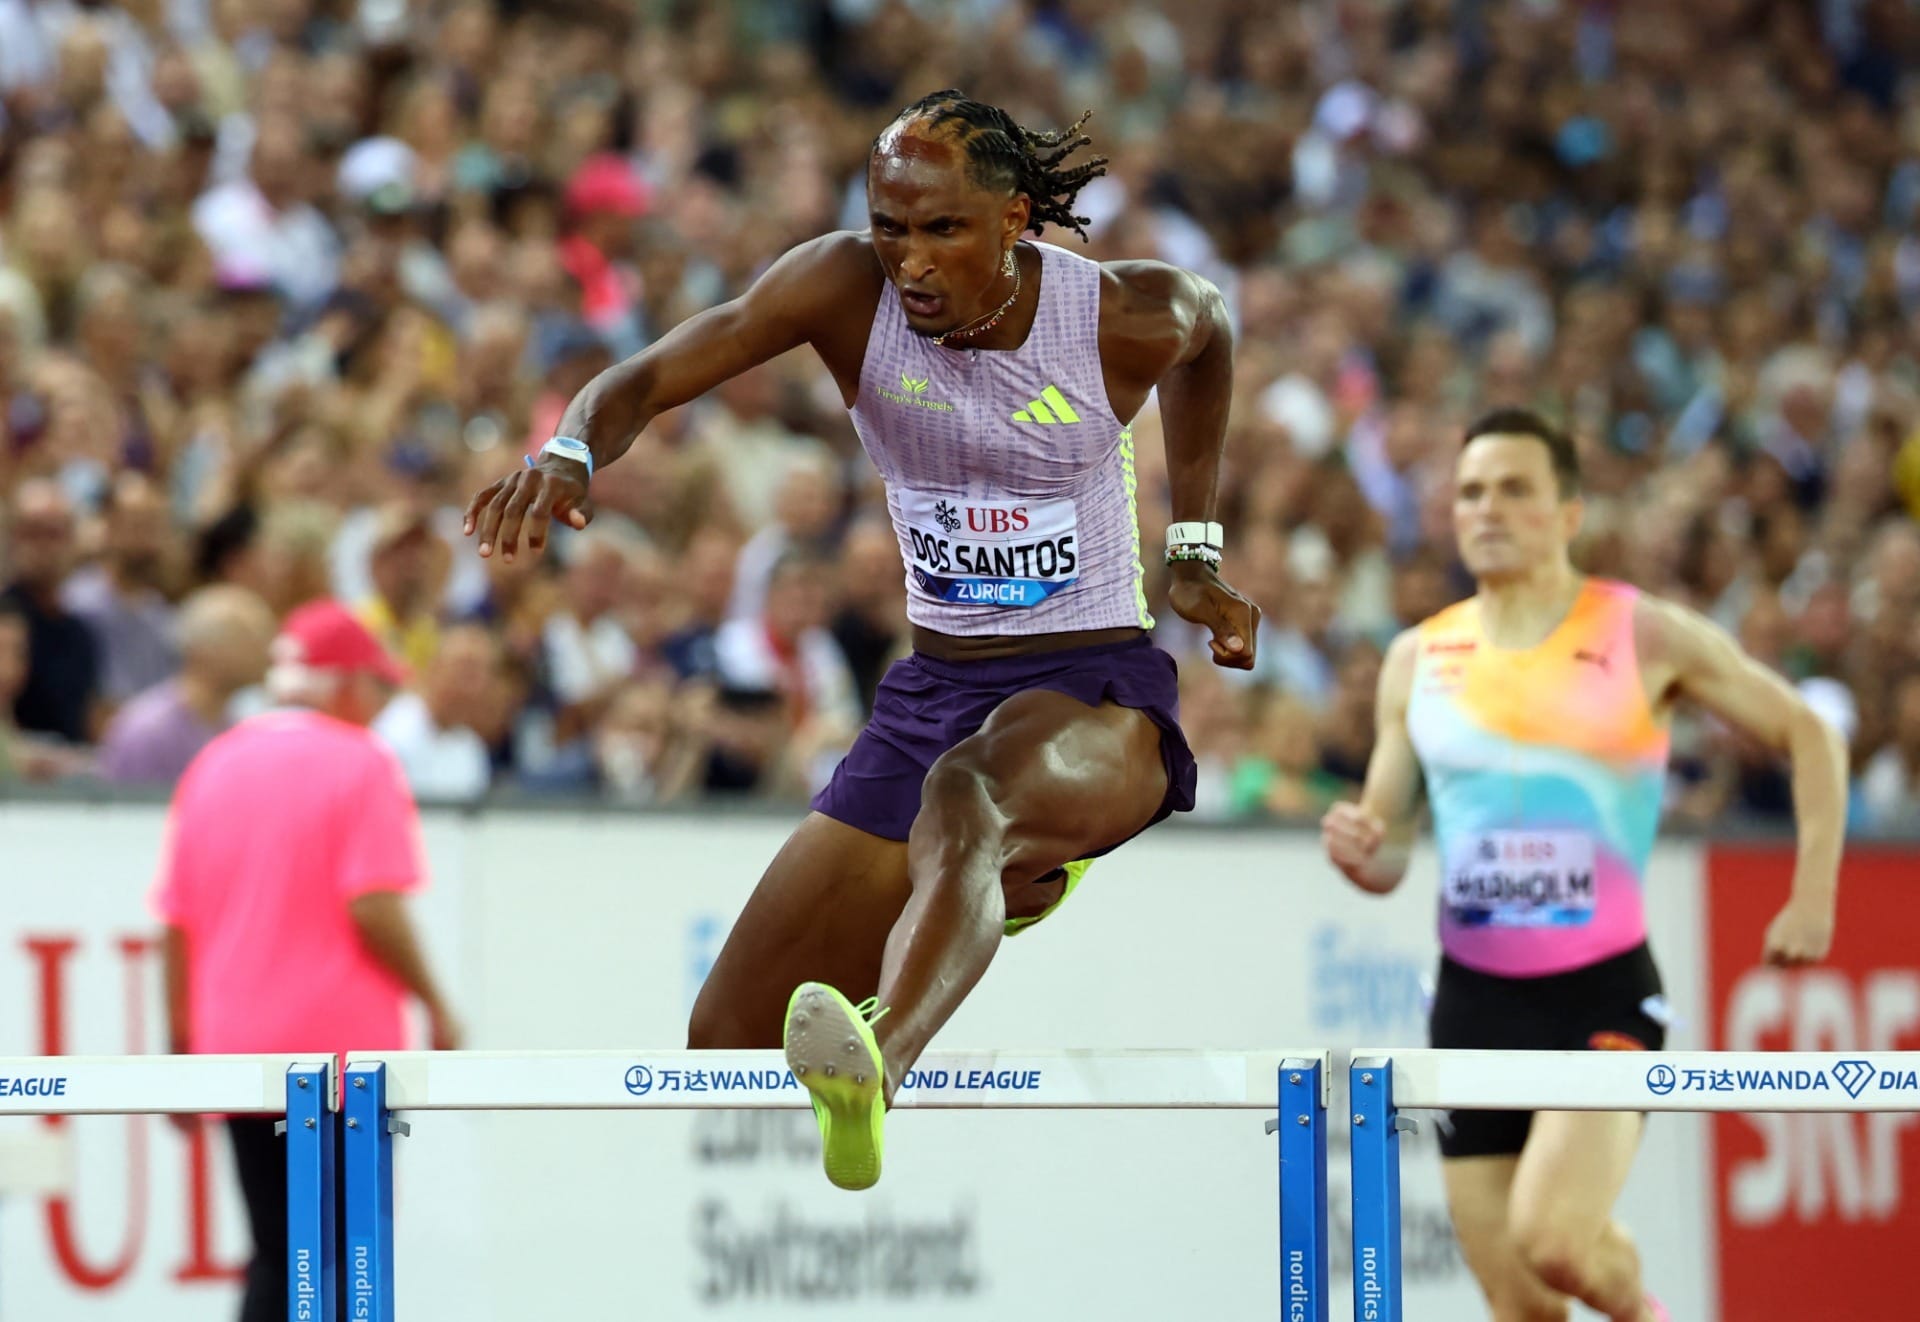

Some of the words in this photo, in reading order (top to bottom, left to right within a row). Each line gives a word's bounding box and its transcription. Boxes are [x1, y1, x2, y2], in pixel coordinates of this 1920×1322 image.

[914, 397, 954, 413] Angels
[965, 506, 1029, 533] UBS
[909, 527, 951, 572] DOS
[955, 536, 1076, 578] SANTOS
[955, 583, 1025, 601] ZURICH
[0, 1077, 67, 1097] EAGUE
[954, 1070, 1041, 1090] LEAGUE
[1879, 1071, 1920, 1090] DIA
[297, 1248, 315, 1322] nordics
[353, 1245, 374, 1322] nordics
[1362, 1247, 1382, 1322] nordics
